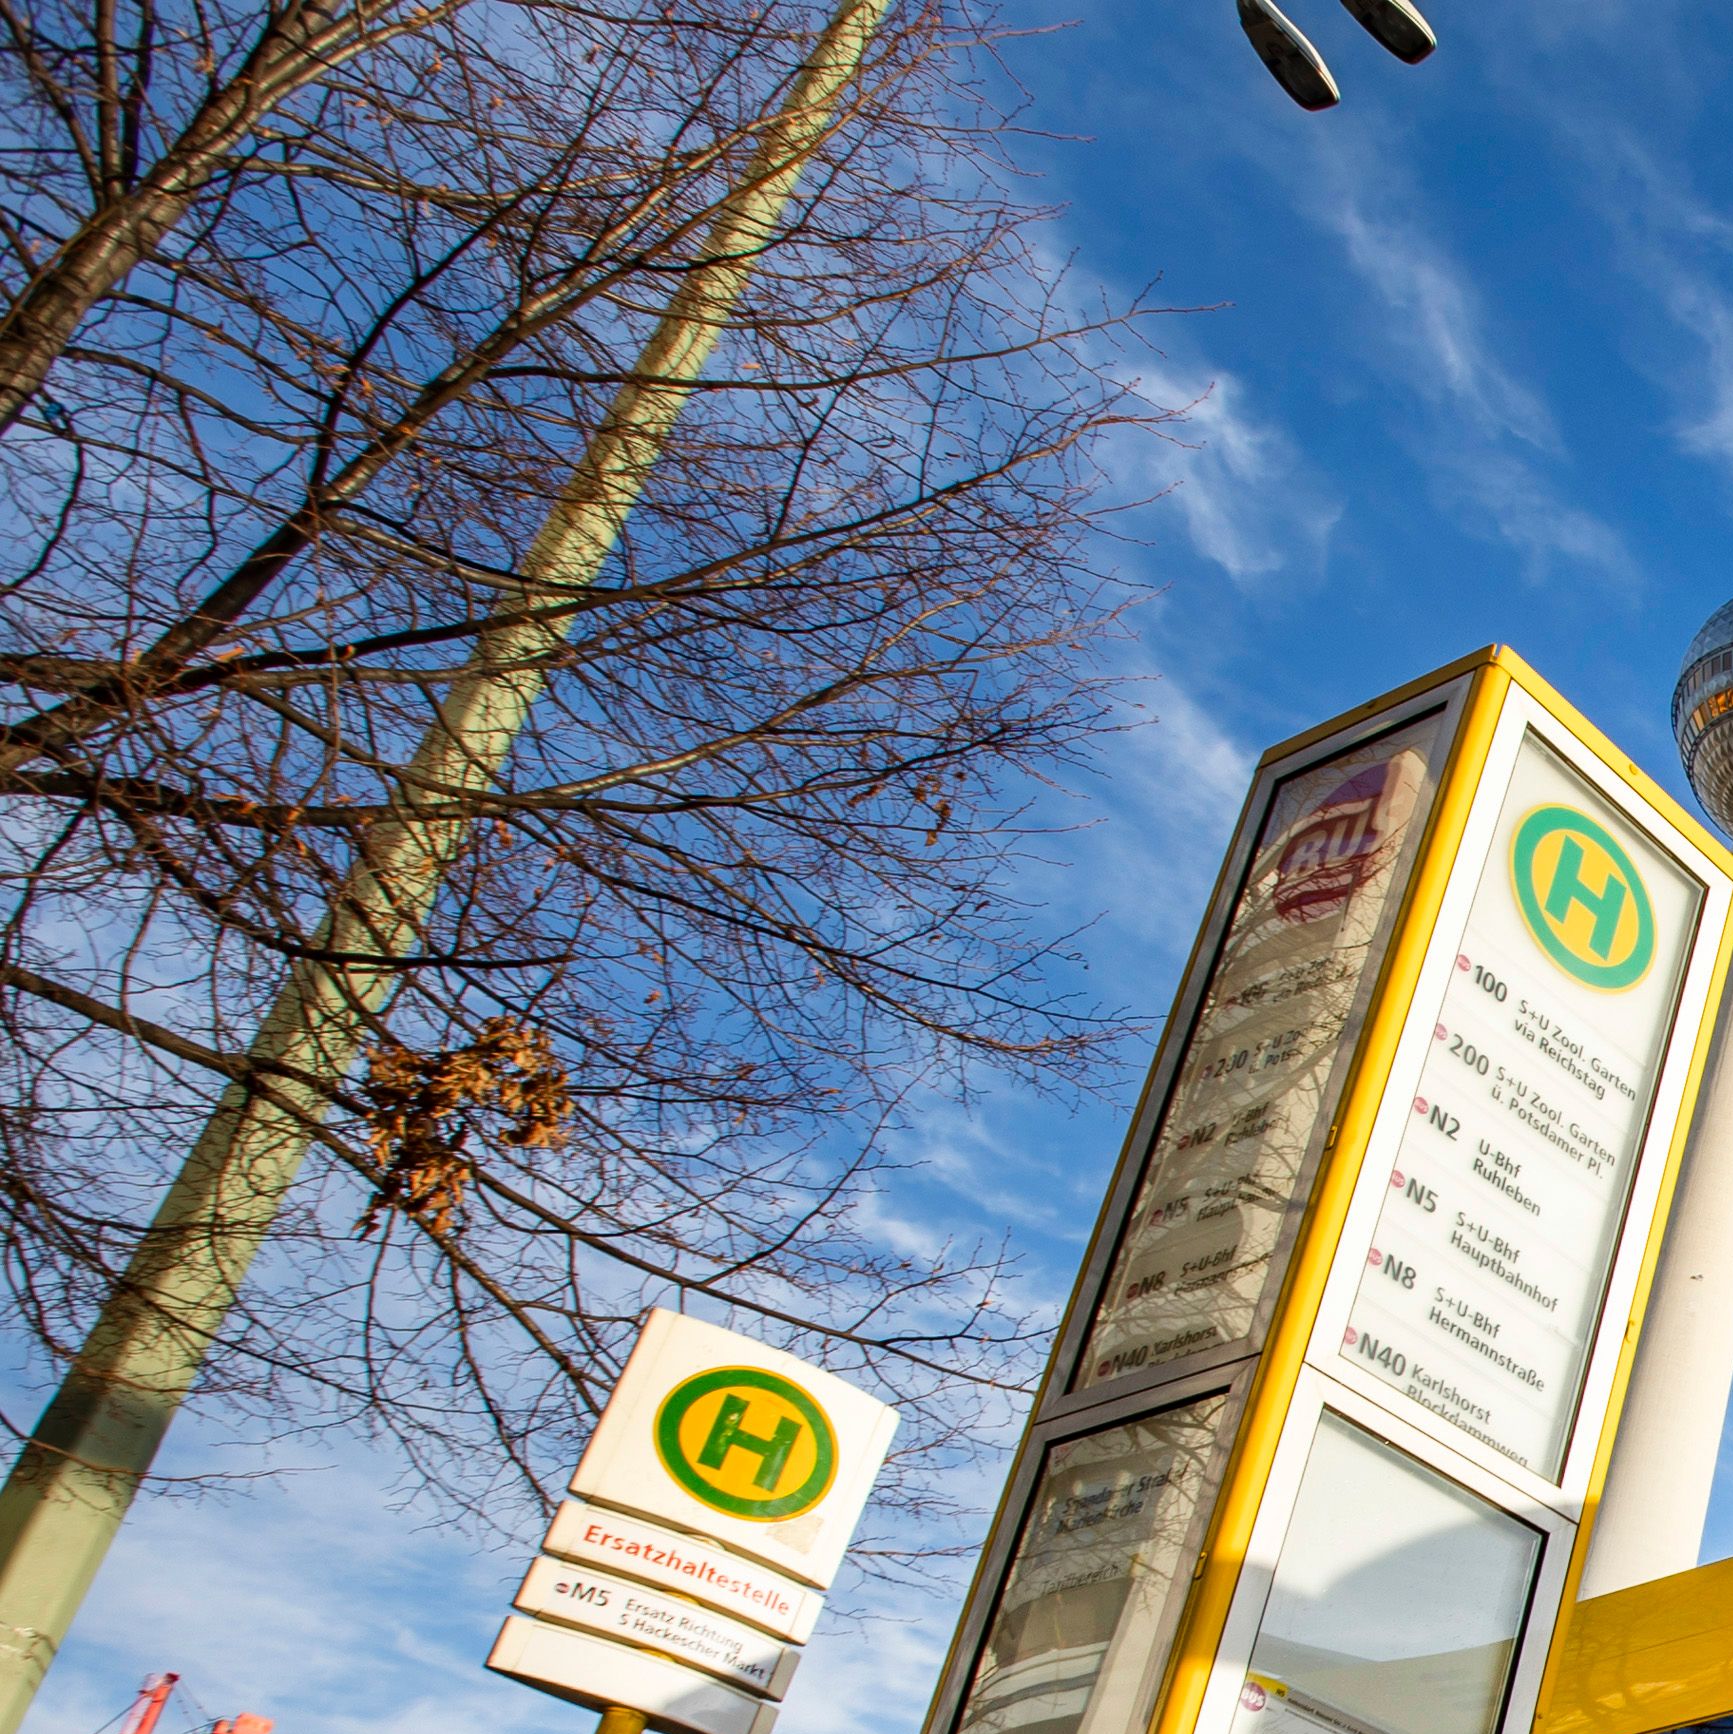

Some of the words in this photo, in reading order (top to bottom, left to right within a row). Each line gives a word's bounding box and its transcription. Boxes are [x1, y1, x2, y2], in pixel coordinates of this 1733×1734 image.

[1475, 965, 1507, 1002] 100
[1518, 1000, 1549, 1031] S+U
[1552, 1025, 1586, 1062] Zool.
[1591, 1057, 1637, 1101] Garten
[1515, 1019, 1535, 1042] via
[1539, 1036, 1606, 1101] Reichstag
[1429, 1104, 1461, 1141] N2
[1449, 1033, 1490, 1076] 200
[1495, 1065, 1528, 1097] S+U
[1530, 1091, 1564, 1128] Zool.
[1569, 1122, 1616, 1167] Garten
[1509, 1099, 1584, 1163] Potsdamer
[1588, 1158, 1603, 1179] Pl.
[1472, 1158, 1541, 1216] Ruhleben
[1479, 1139, 1523, 1178] U-Bhf
[1406, 1178, 1439, 1213] N5
[1456, 1211, 1521, 1264] S+U-Bhf
[1384, 1254, 1417, 1290] N8
[1434, 1286, 1502, 1339] S+U-Bhf
[1450, 1230, 1558, 1313] Hauptbahnhof
[1358, 1333, 1407, 1376] N40
[1411, 1363, 1493, 1425] Karlshorst
[1429, 1306, 1546, 1392] Hermannstraße
[583, 1524, 790, 1616] Ersatzhaltestelle
[569, 1582, 612, 1606] M5
[624, 1598, 675, 1624] Ersatz
[678, 1617, 744, 1655] Richtung
[632, 1618, 719, 1660] Hackescher
[723, 1652, 765, 1679] Markt
